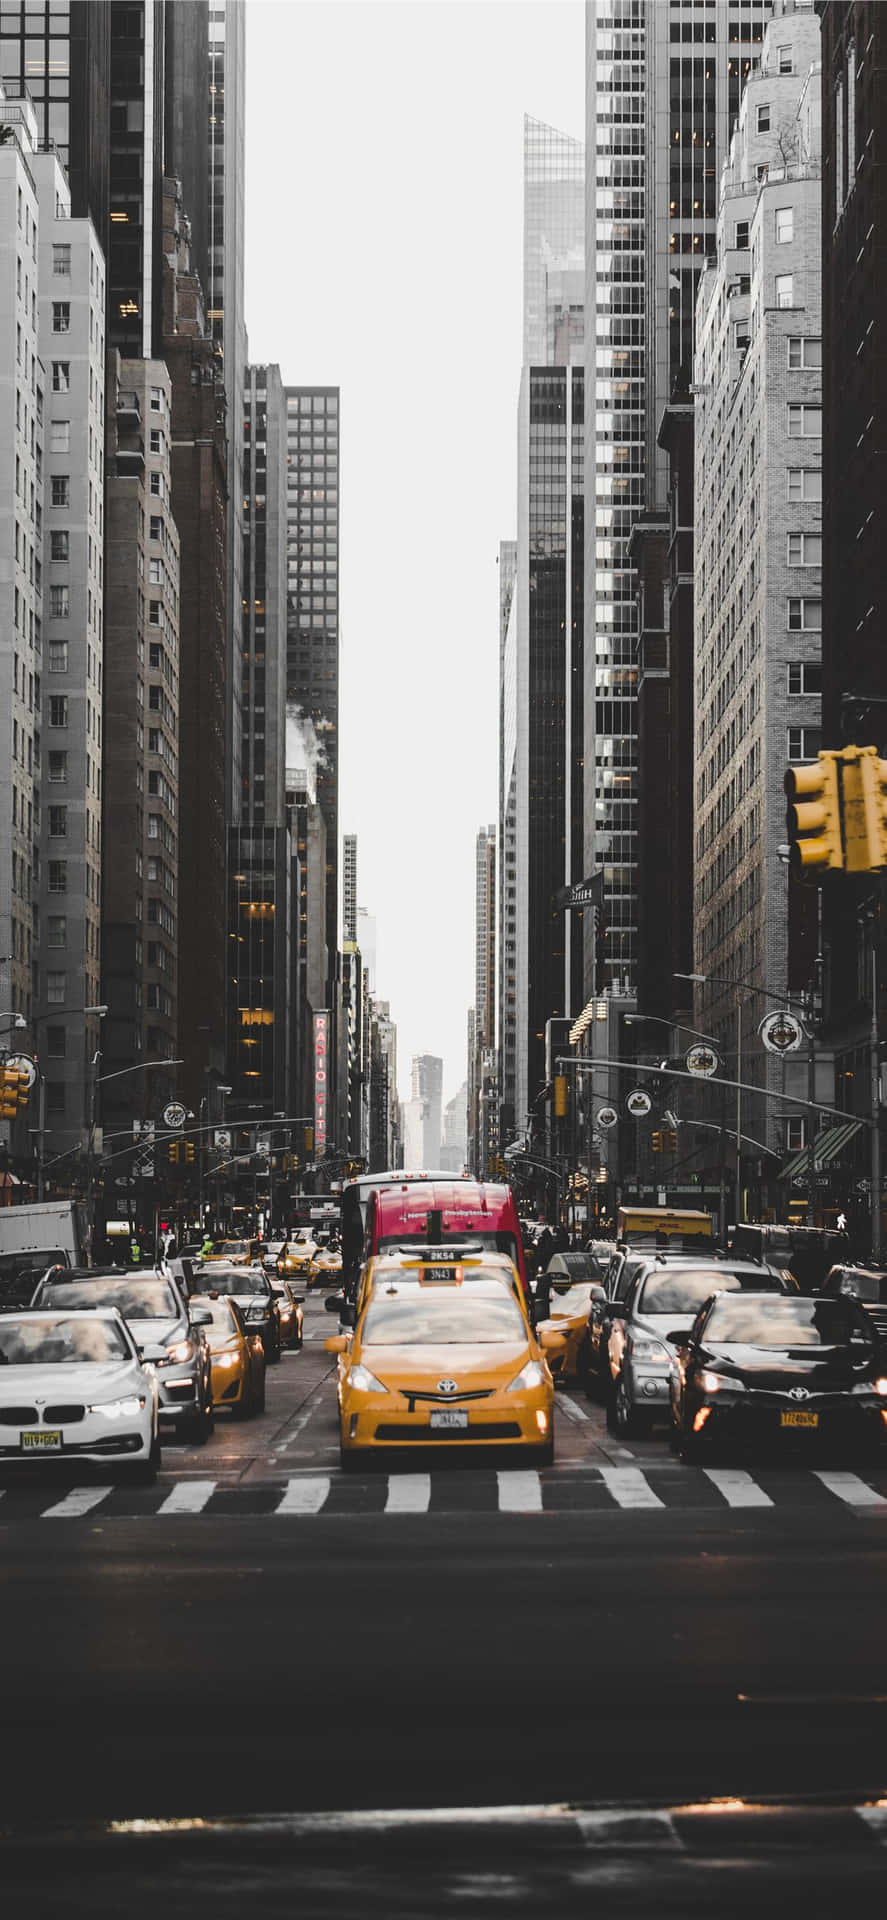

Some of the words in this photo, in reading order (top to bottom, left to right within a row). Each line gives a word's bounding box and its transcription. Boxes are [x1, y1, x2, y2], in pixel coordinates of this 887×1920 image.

[315, 1019, 326, 1081] RADIO
[315, 1093, 326, 1142] CITY
[431, 1252, 454, 1260] 2K54
[430, 1269, 450, 1280] 3N43
